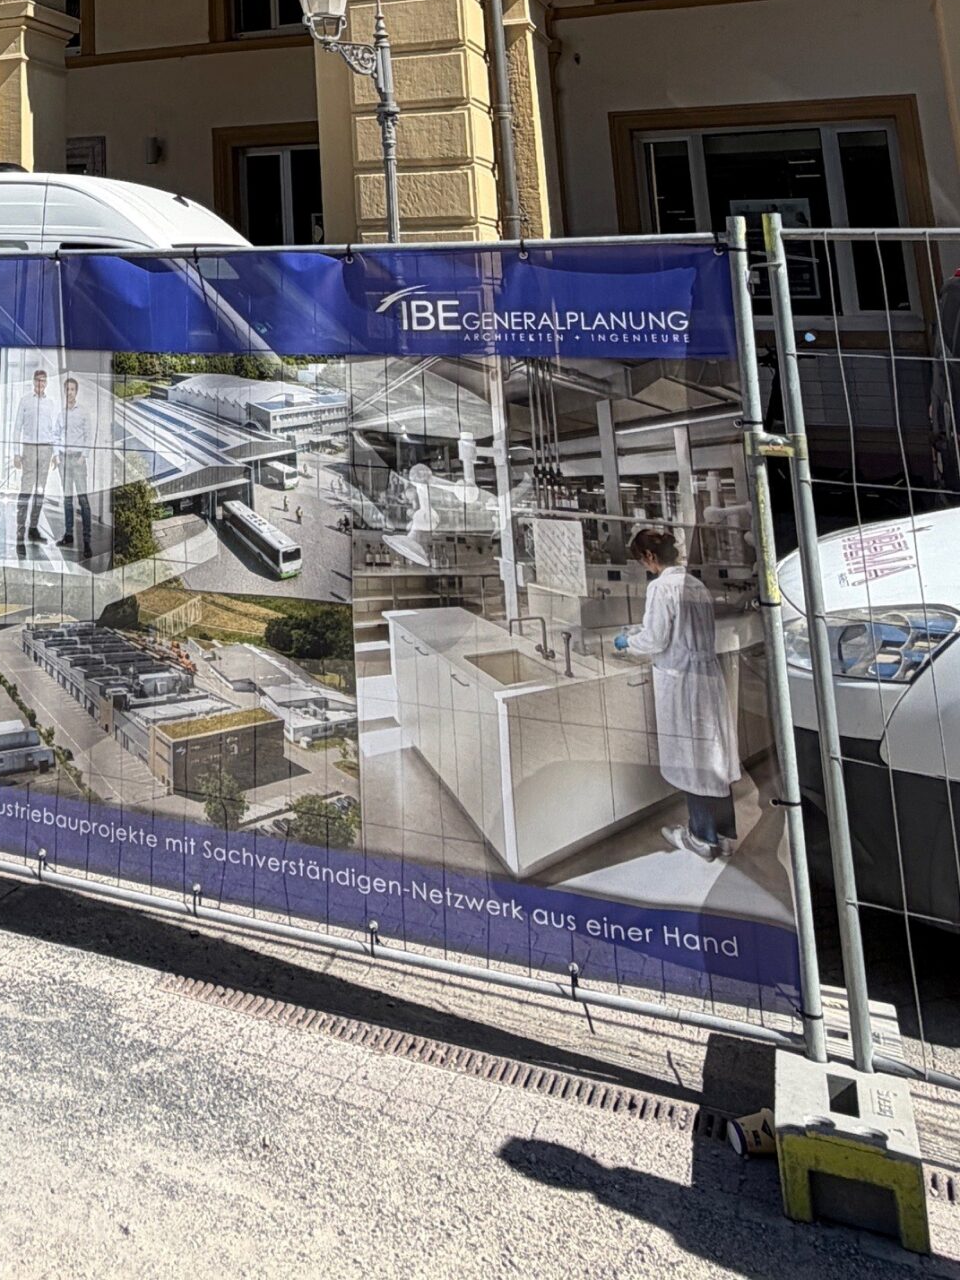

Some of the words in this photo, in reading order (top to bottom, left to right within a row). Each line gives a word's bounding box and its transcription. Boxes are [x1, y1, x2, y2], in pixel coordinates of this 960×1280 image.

[401, 300, 462, 330] IBE
[462, 311, 689, 331] GENERALPLANUNG
[463, 333, 564, 343] ARCHITEKTEN
[591, 333, 690, 343] INGENIEURE
[166, 836, 195, 855] mit
[203, 841, 523, 920] Sachverständigen-Netzwerk
[533, 909, 576, 931] aus
[587, 917, 652, 944] einer
[664, 926, 739, 958] Hand
